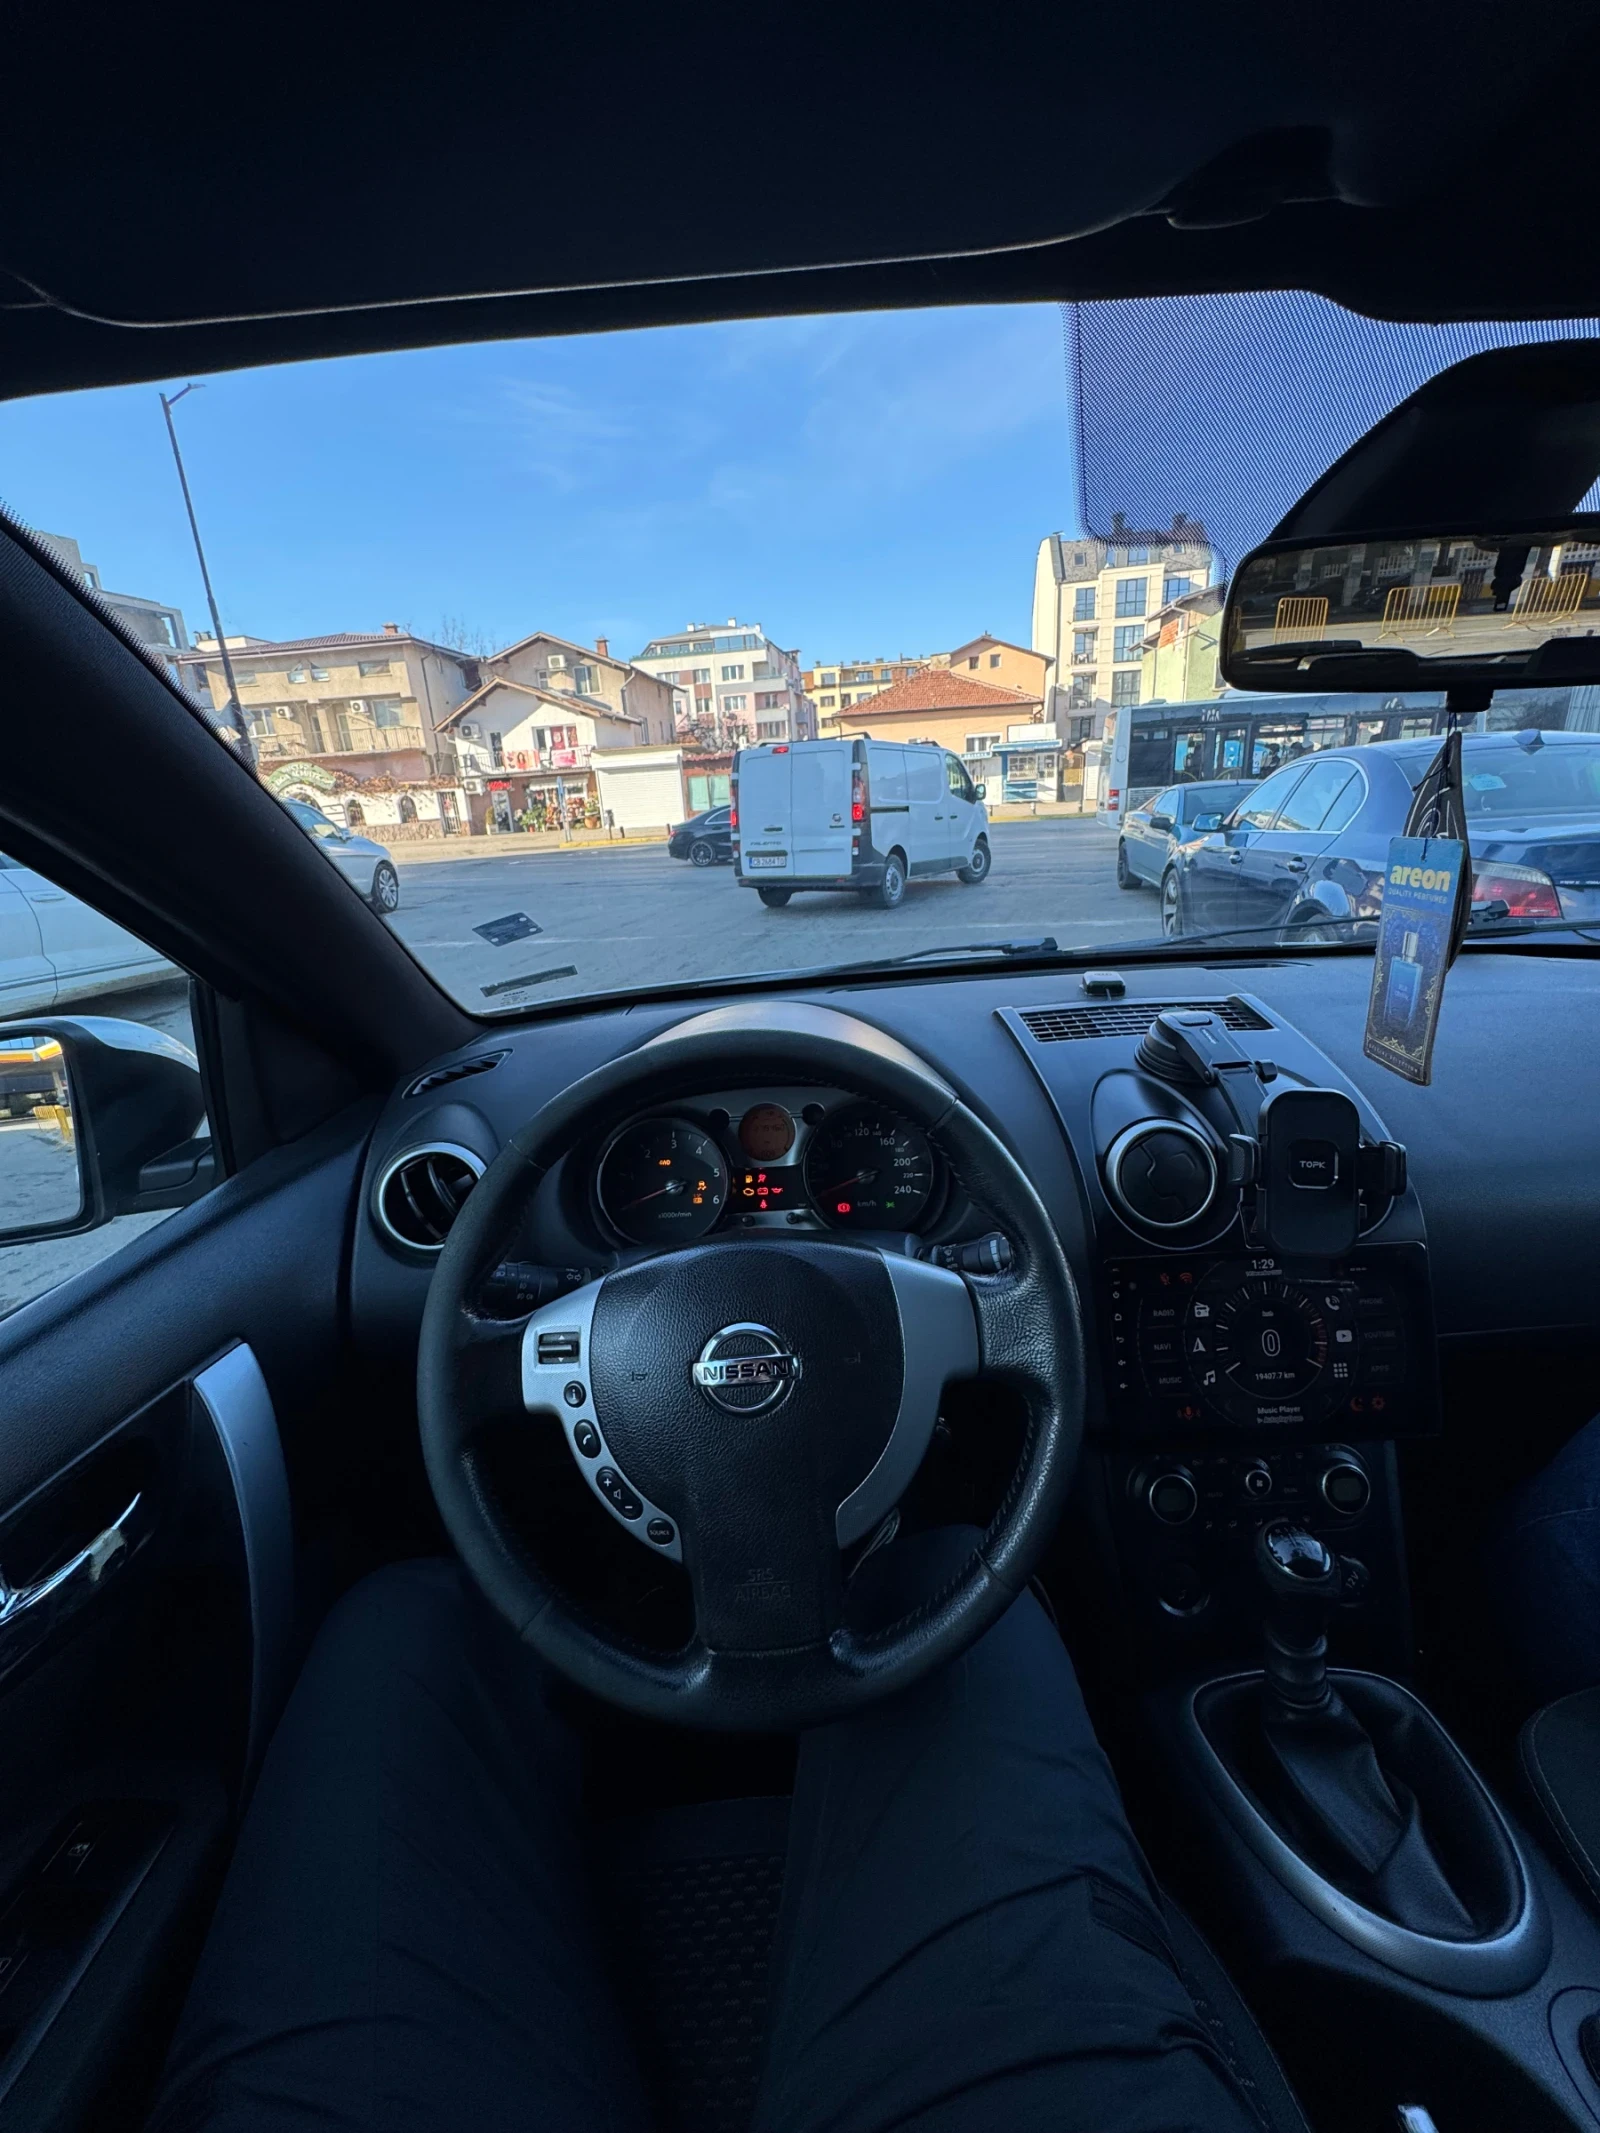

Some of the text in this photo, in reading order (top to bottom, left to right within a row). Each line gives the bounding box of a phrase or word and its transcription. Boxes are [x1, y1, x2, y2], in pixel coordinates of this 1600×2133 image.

[1389, 865, 1450, 892] areon
[854, 1128, 869, 1136] 120
[671, 1140, 678, 1149] 3
[880, 1137, 895, 1146] 160
[644, 1149, 652, 1158] 2
[695, 1146, 702, 1155] 4
[893, 1157, 911, 1167] 200
[1299, 1160, 1326, 1169] TOPK
[713, 1168, 720, 1177] 5
[894, 1185, 912, 1194] 240
[712, 1195, 720, 1204] 6
[1252, 1258, 1275, 1269] 1:29
[703, 1360, 789, 1381] NISSAN
